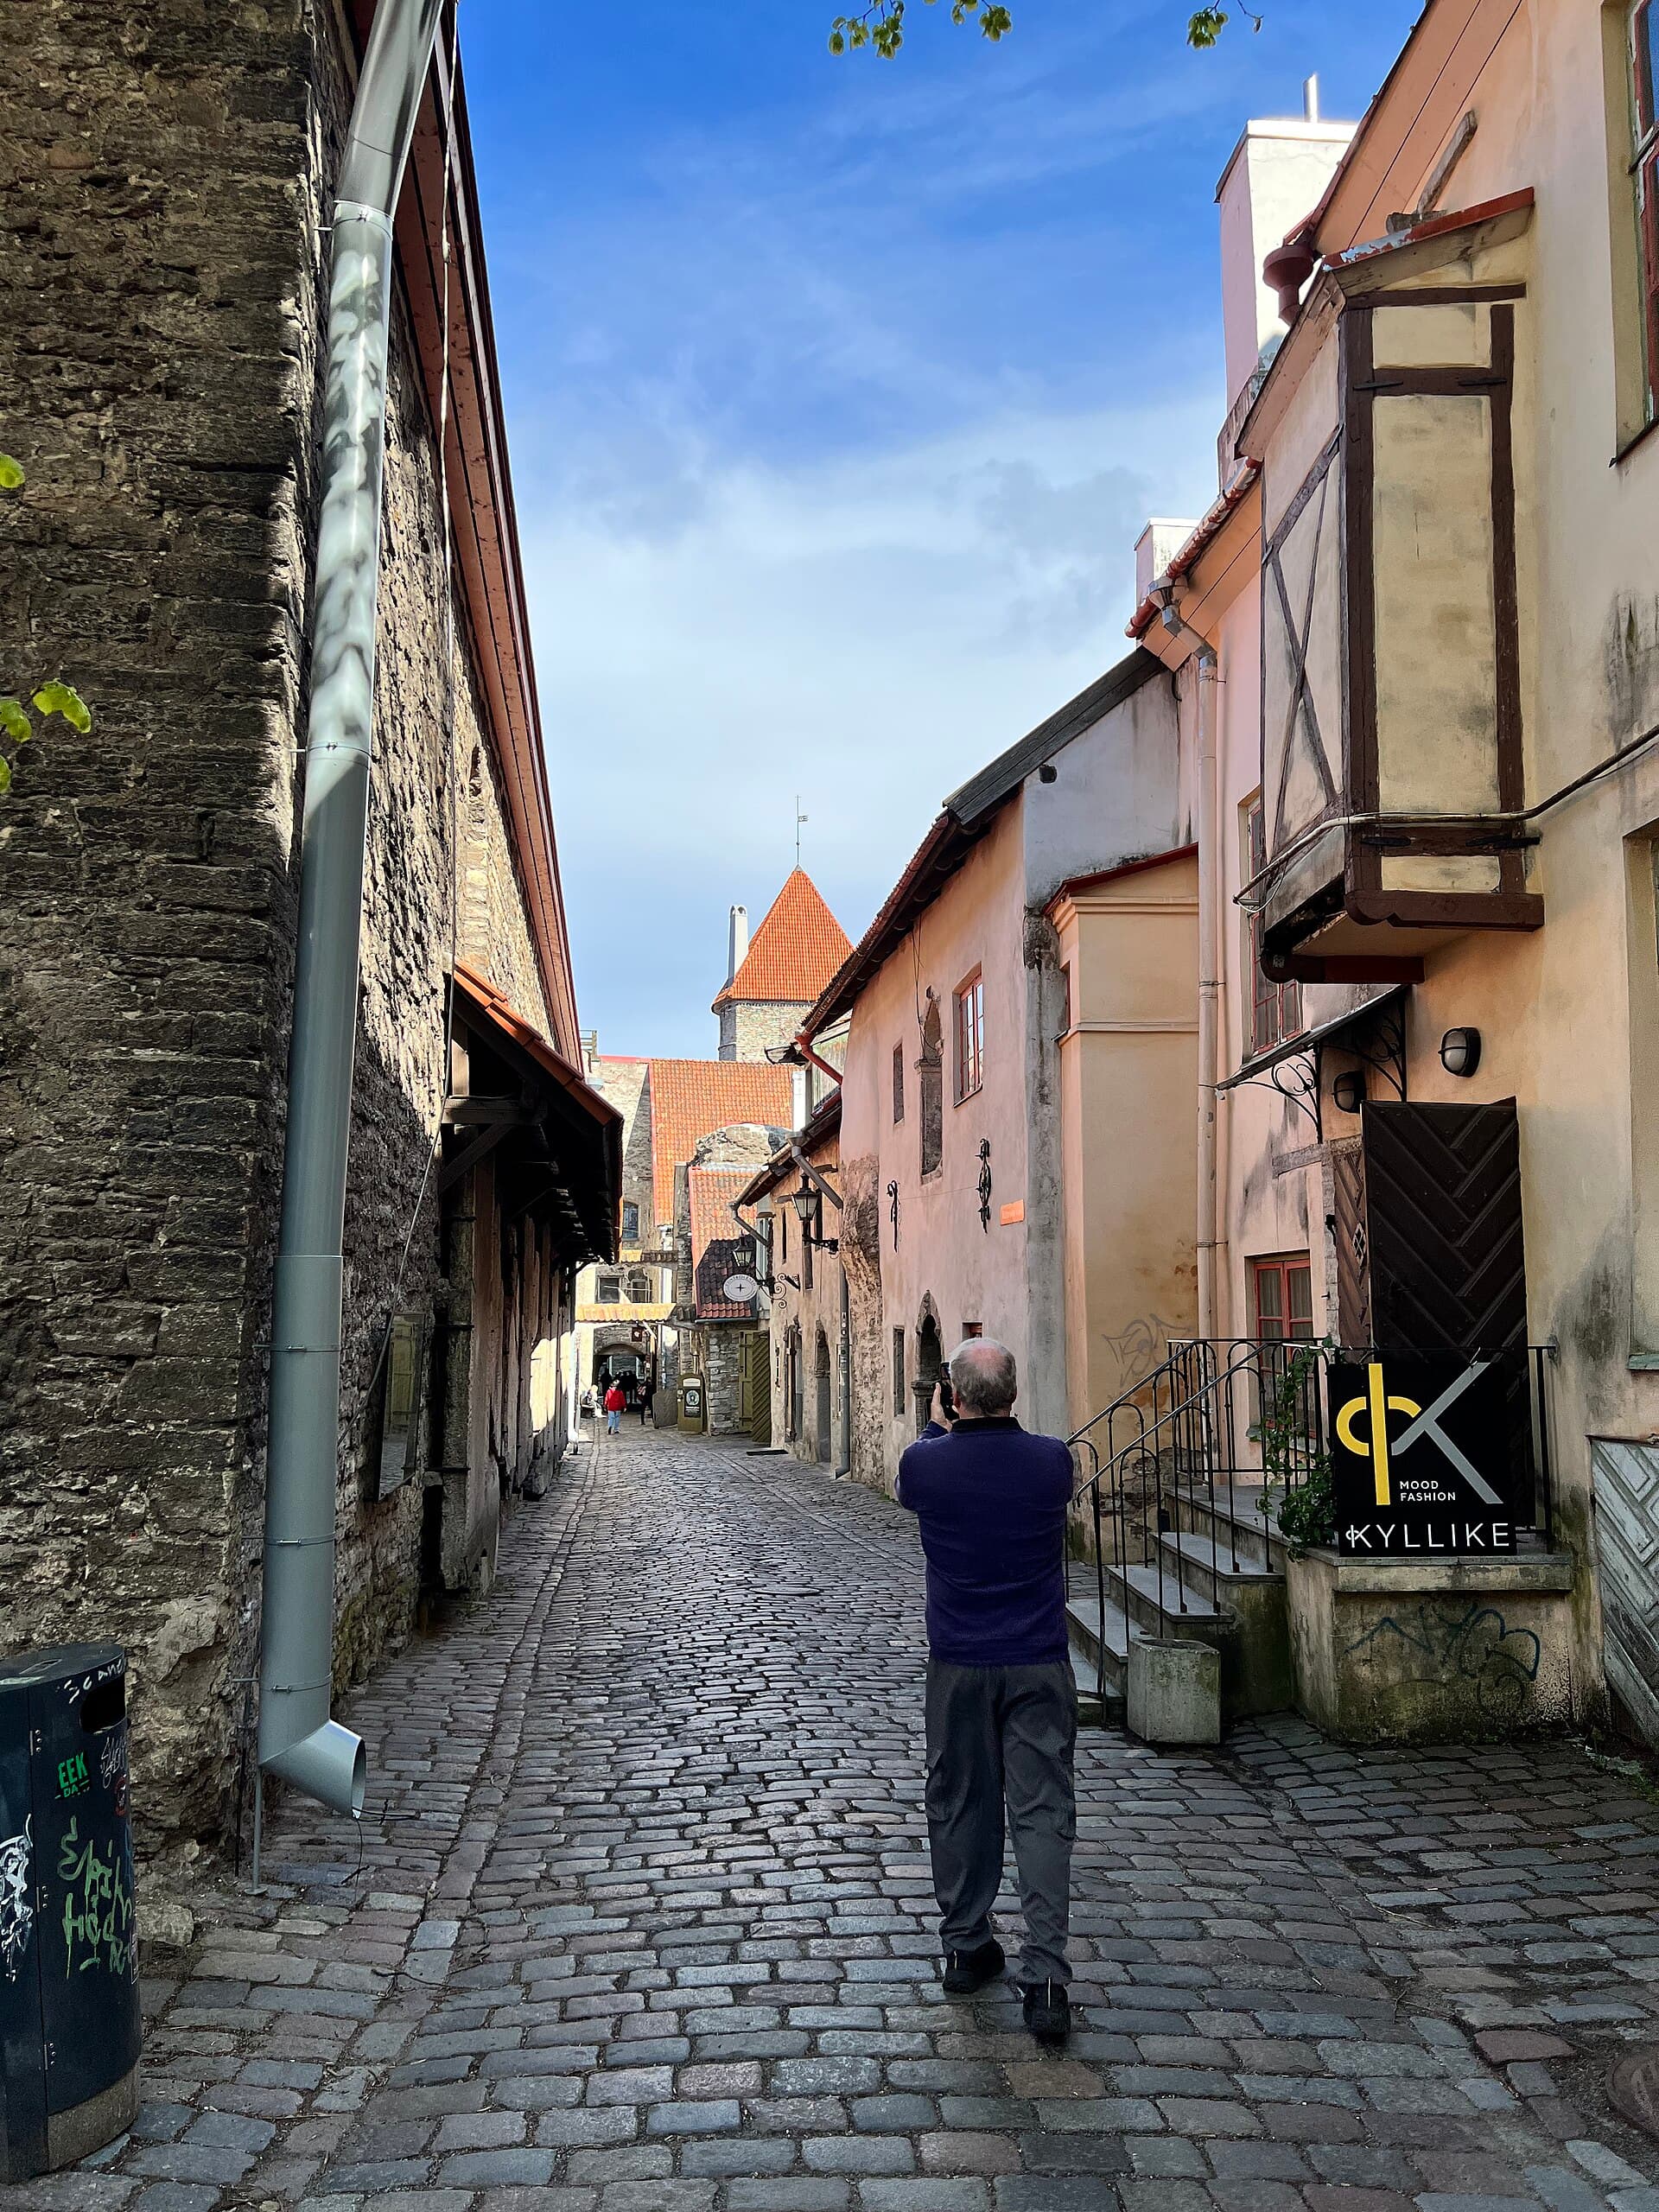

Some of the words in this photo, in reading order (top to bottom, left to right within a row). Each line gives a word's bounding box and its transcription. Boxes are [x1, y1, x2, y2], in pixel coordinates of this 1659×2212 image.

[1399, 1480, 1440, 1491] MOOD
[1400, 1491, 1457, 1502] FASHION
[1344, 1522, 1510, 1548] KYLLIKE
